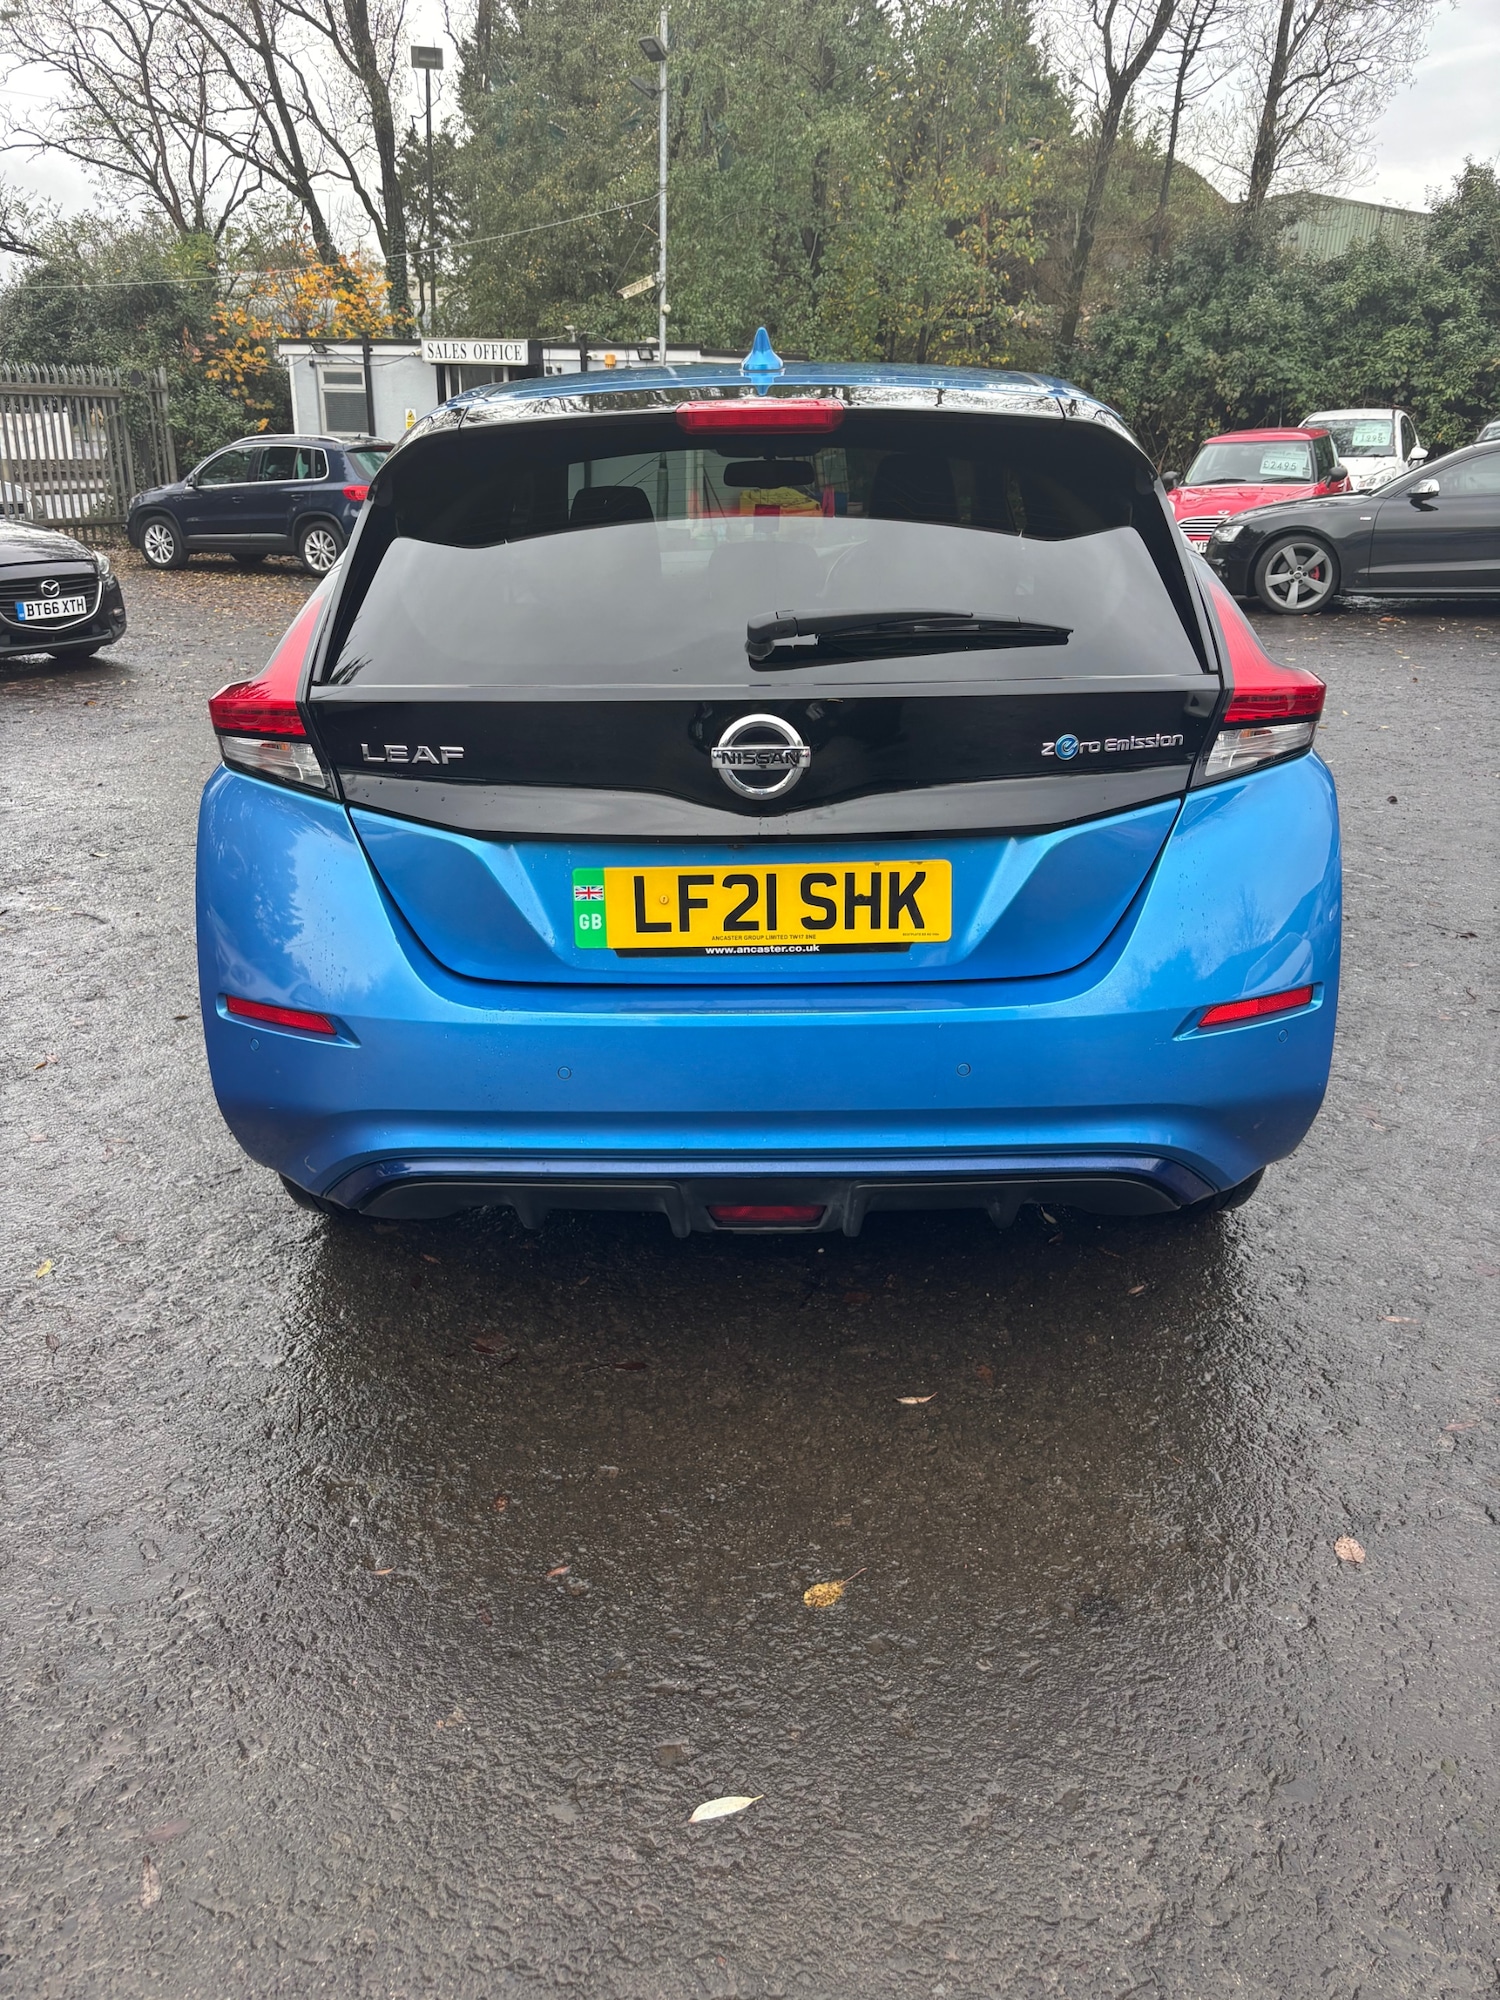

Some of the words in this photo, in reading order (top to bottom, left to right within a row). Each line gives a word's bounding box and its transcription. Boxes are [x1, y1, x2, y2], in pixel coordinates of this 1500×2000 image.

[427, 342, 467, 360] SALES
[473, 343, 523, 361] OFFICE
[26, 602, 60, 617] BT66
[62, 598, 84, 614] XTH
[1104, 733, 1184, 751] Emission
[360, 743, 465, 764] LEAF
[721, 751, 800, 766] NISSAN
[633, 873, 777, 933] LF21
[800, 871, 926, 931] SHK
[579, 913, 602, 930] GB
[705, 944, 820, 954] www.ancaster.co.uk
